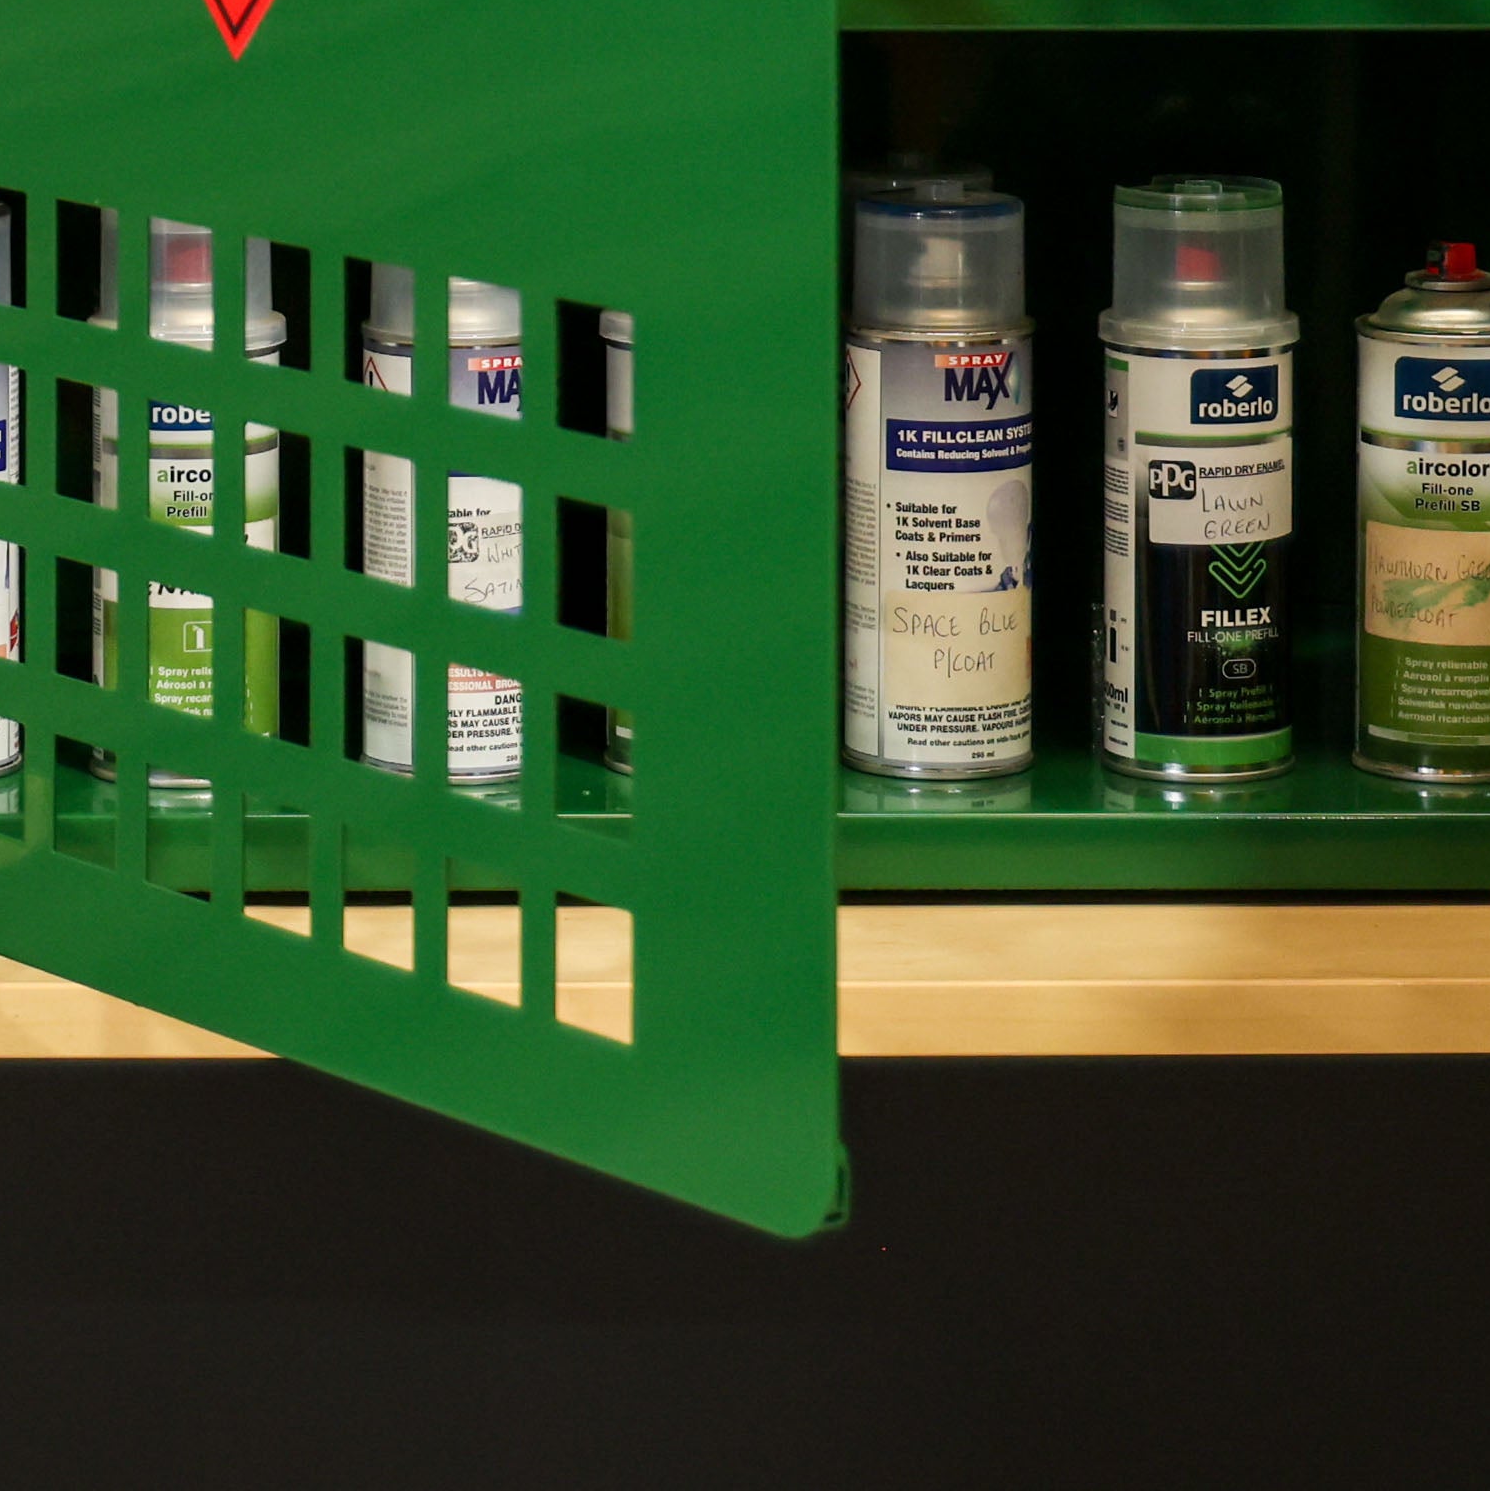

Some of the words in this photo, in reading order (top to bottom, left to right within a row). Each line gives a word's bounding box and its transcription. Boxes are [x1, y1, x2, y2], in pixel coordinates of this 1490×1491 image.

[949, 354, 1003, 366] SPRAY
[944, 352, 1013, 410] MAX
[1198, 396, 1273, 418] roberlo
[898, 430, 917, 443] 1K
[923, 429, 1003, 444] FILLCLEAN
[896, 448, 935, 459] Contains
[938, 449, 980, 461] Reducing
[1406, 457, 1490, 477] aircolor
[1150, 463, 1195, 496] PPG
[1199, 466, 1232, 476] RAPID
[1235, 464, 1254, 475] DRY
[1421, 483, 1474, 497] Fill-one
[1202, 487, 1263, 513] LAWN
[1415, 497, 1456, 512] Prefill
[1461, 498, 1481, 512] SB
[167, 506, 207, 518] Prefill
[896, 502, 938, 514] Suitable
[942, 504, 957, 514] for
[896, 516, 909, 527] 1K
[912, 518, 952, 529] Solvent
[956, 518, 981, 529] Base
[895, 530, 924, 542] Coats
[928, 532, 935, 542] &
[939, 532, 981, 543] Primers
[906, 551, 929, 562] Also
[932, 551, 975, 562] Suitable
[978, 551, 992, 561] for
[907, 565, 919, 575] 1K
[923, 565, 950, 576] Clear
[954, 565, 982, 576] Coats
[985, 564, 993, 575] &
[906, 578, 955, 592] Lacquers
[892, 606, 962, 638] SPACE
[979, 607, 1018, 636] BLUE
[1201, 606, 1272, 627] FILLEX
[1187, 631, 1241, 643] FILL-ONE
[1245, 627, 1279, 640] PREFILL
[158, 667, 188, 677] Spray
[1232, 663, 1248, 675] SB
[156, 679, 196, 689] Aérosol
[154, 693, 183, 703] Spray
[1209, 688, 1237, 699] Spray
[466, 707, 517, 718] FLAMMABLE
[1196, 702, 1226, 712] Spray
[889, 711, 921, 722] VAPORS
[925, 713, 943, 723] MAY
[946, 714, 976, 723] CAUSE
[978, 711, 1002, 722] FLASH
[461, 720, 480, 728] MAY
[482, 719, 509, 727] CAUSE
[897, 724, 928, 732] UNDER
[982, 720, 1014, 732] VAPOURS
[467, 744, 486, 752] other
[907, 738, 927, 747] Read
[930, 738, 951, 747] other
[953, 737, 985, 747] cautions
